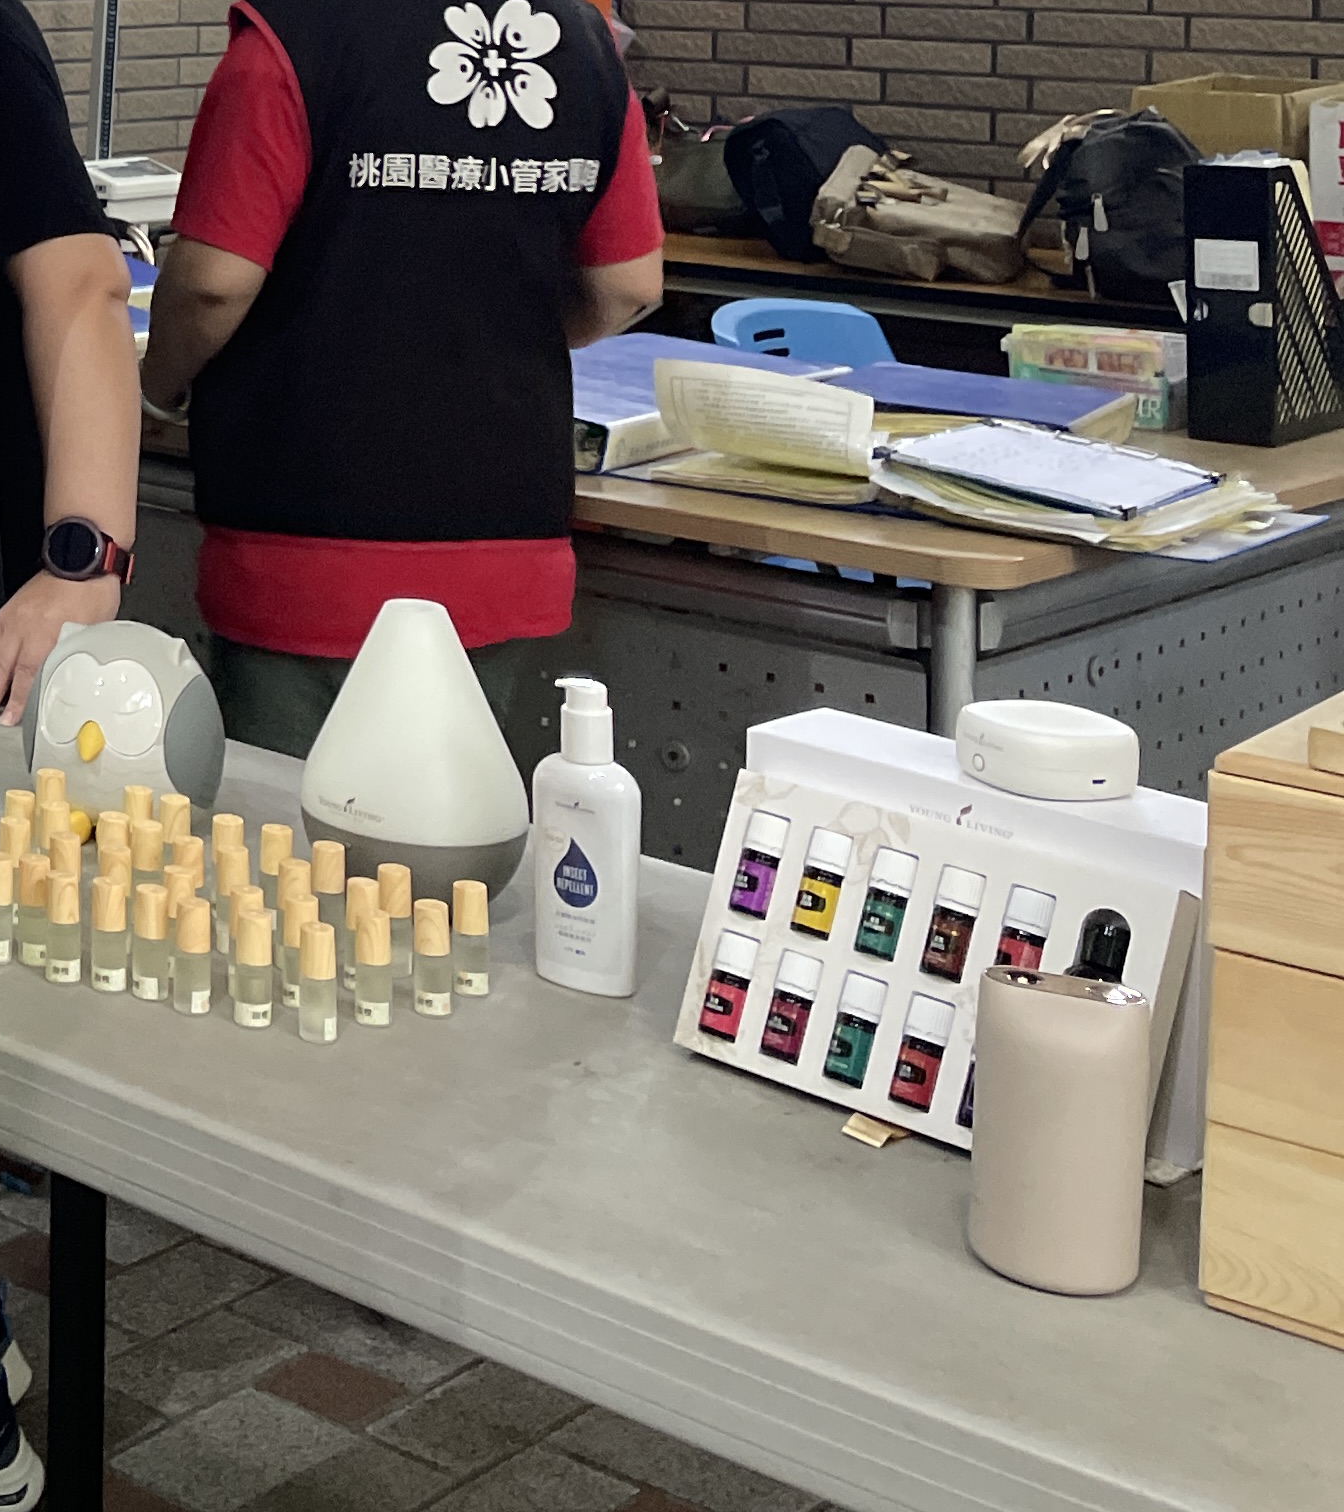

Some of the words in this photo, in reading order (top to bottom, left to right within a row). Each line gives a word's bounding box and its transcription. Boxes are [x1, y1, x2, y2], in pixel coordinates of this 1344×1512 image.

[910, 804, 952, 823] YOUNG
[562, 865, 588, 881] INSECT
[556, 877, 594, 896] REPELLENT
